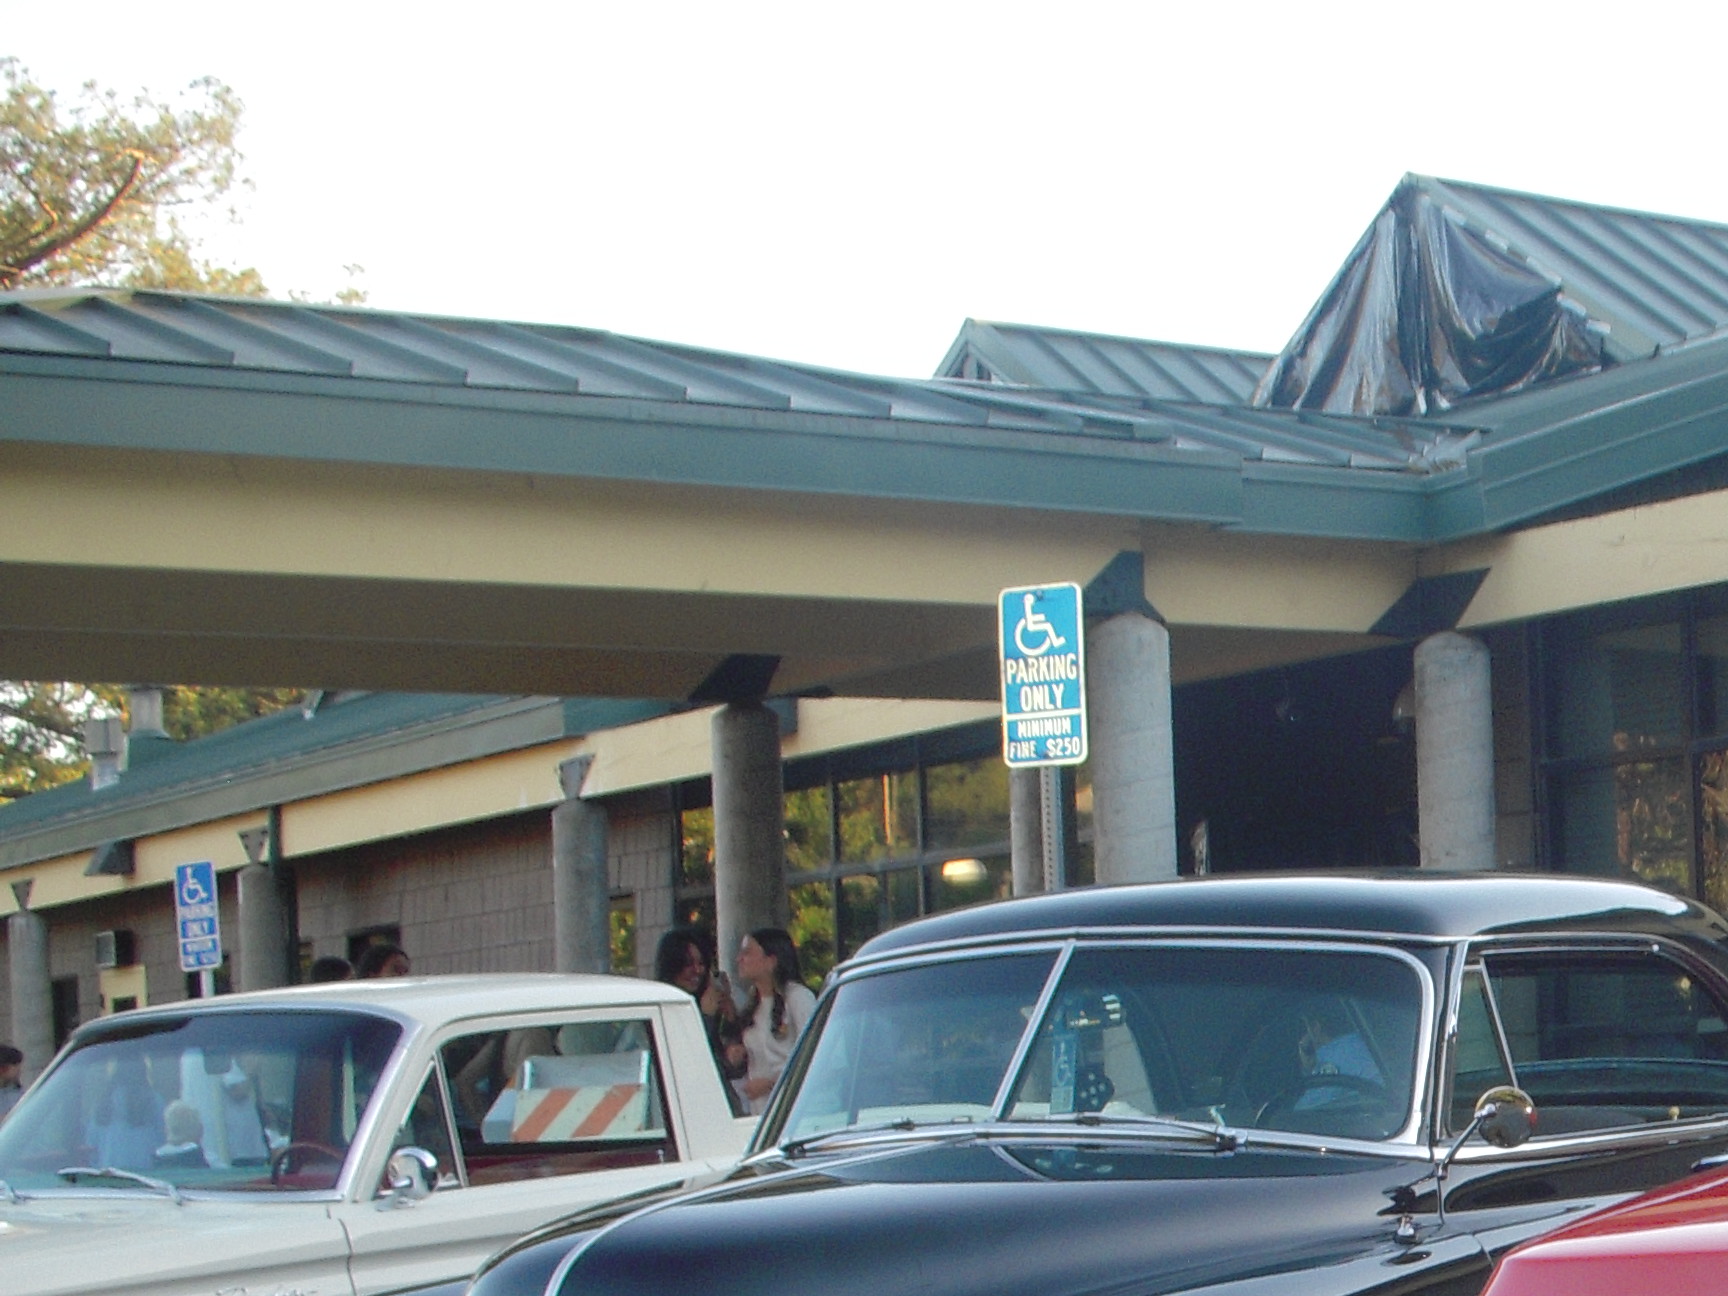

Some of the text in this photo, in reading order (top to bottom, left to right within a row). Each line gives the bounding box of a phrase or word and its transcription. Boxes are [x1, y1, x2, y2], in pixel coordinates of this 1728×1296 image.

[1006, 652, 1078, 684] PARKING
[1019, 683, 1065, 712] ONLY
[1017, 717, 1072, 739] MINIMUM
[1009, 737, 1080, 760] FINE $250
